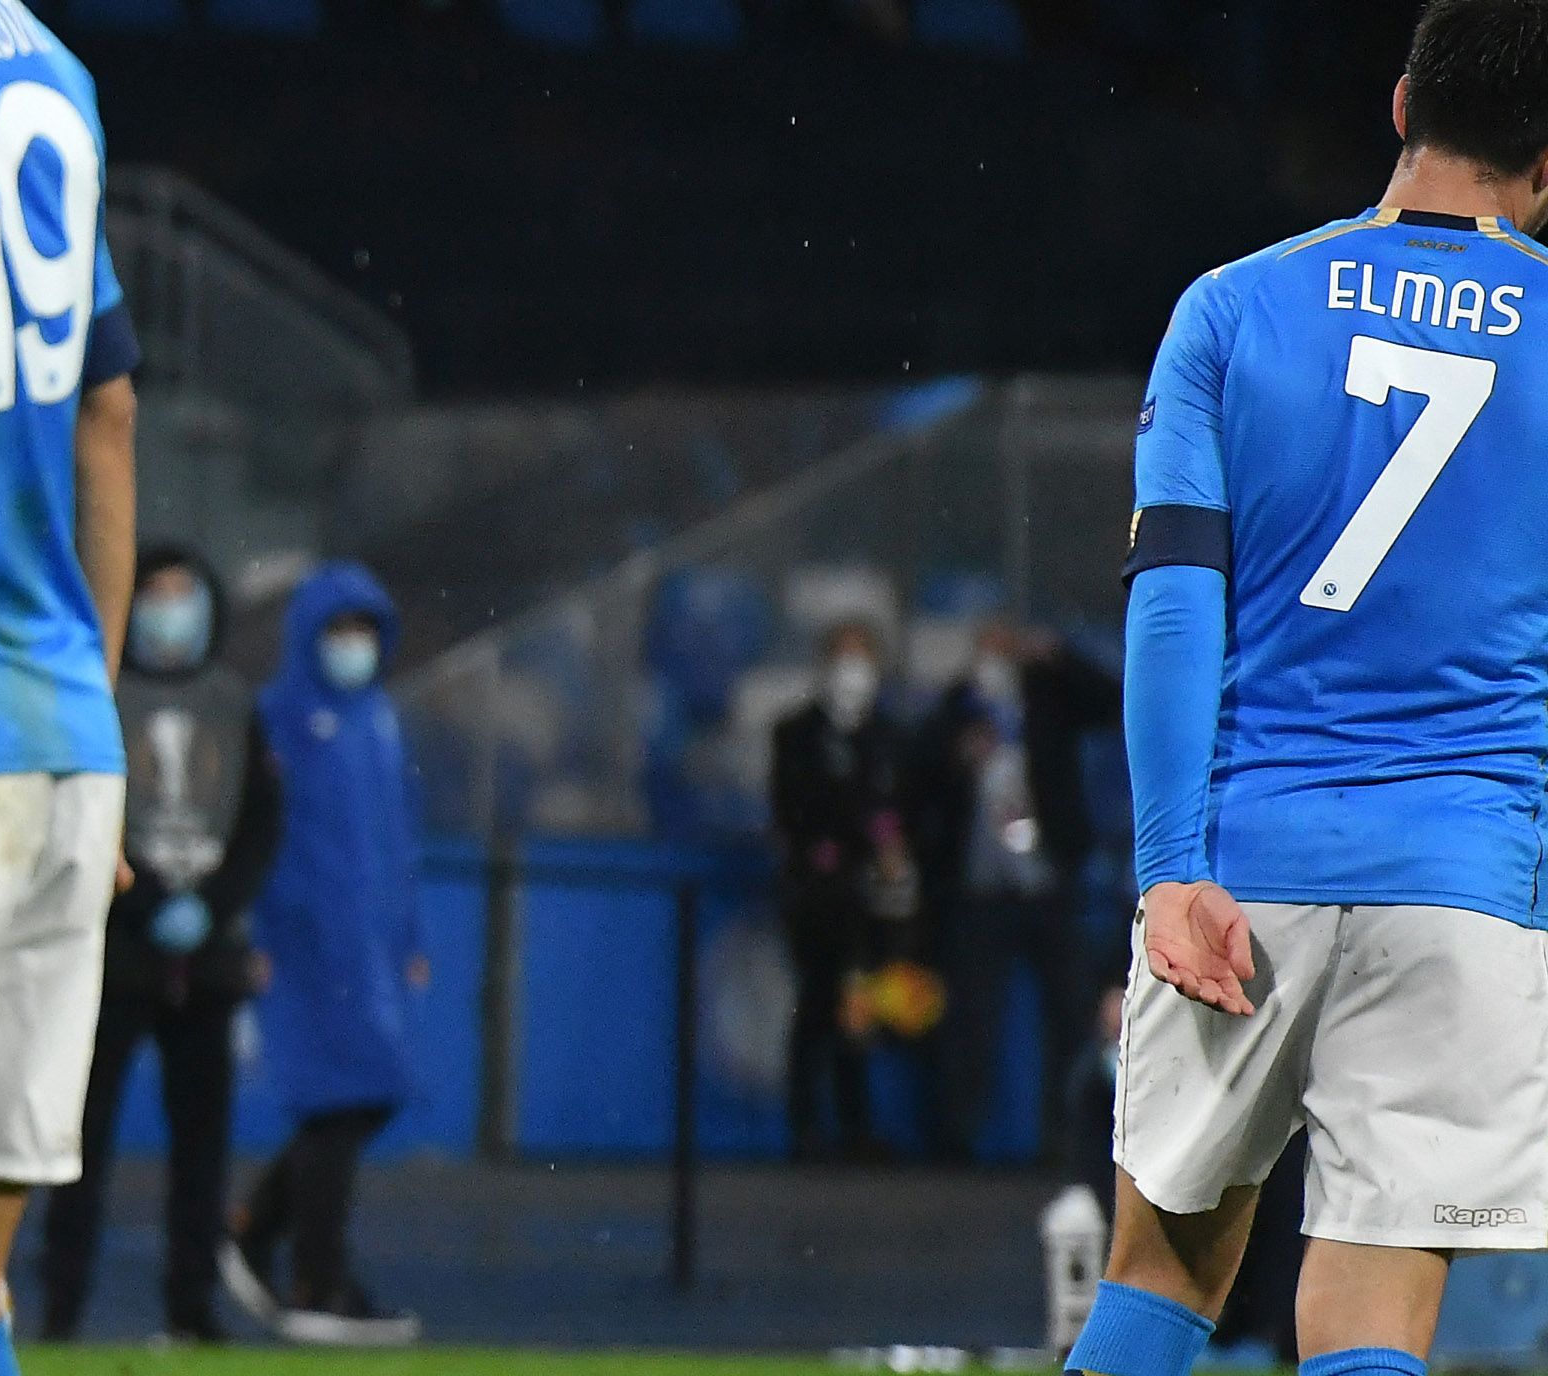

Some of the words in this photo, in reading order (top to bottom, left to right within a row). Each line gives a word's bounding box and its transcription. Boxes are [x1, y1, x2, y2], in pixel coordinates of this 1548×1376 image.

[1328, 261, 1523, 338] ELMAS
[1299, 335, 1497, 612] 7
[1433, 1204, 1528, 1227] Kappa
